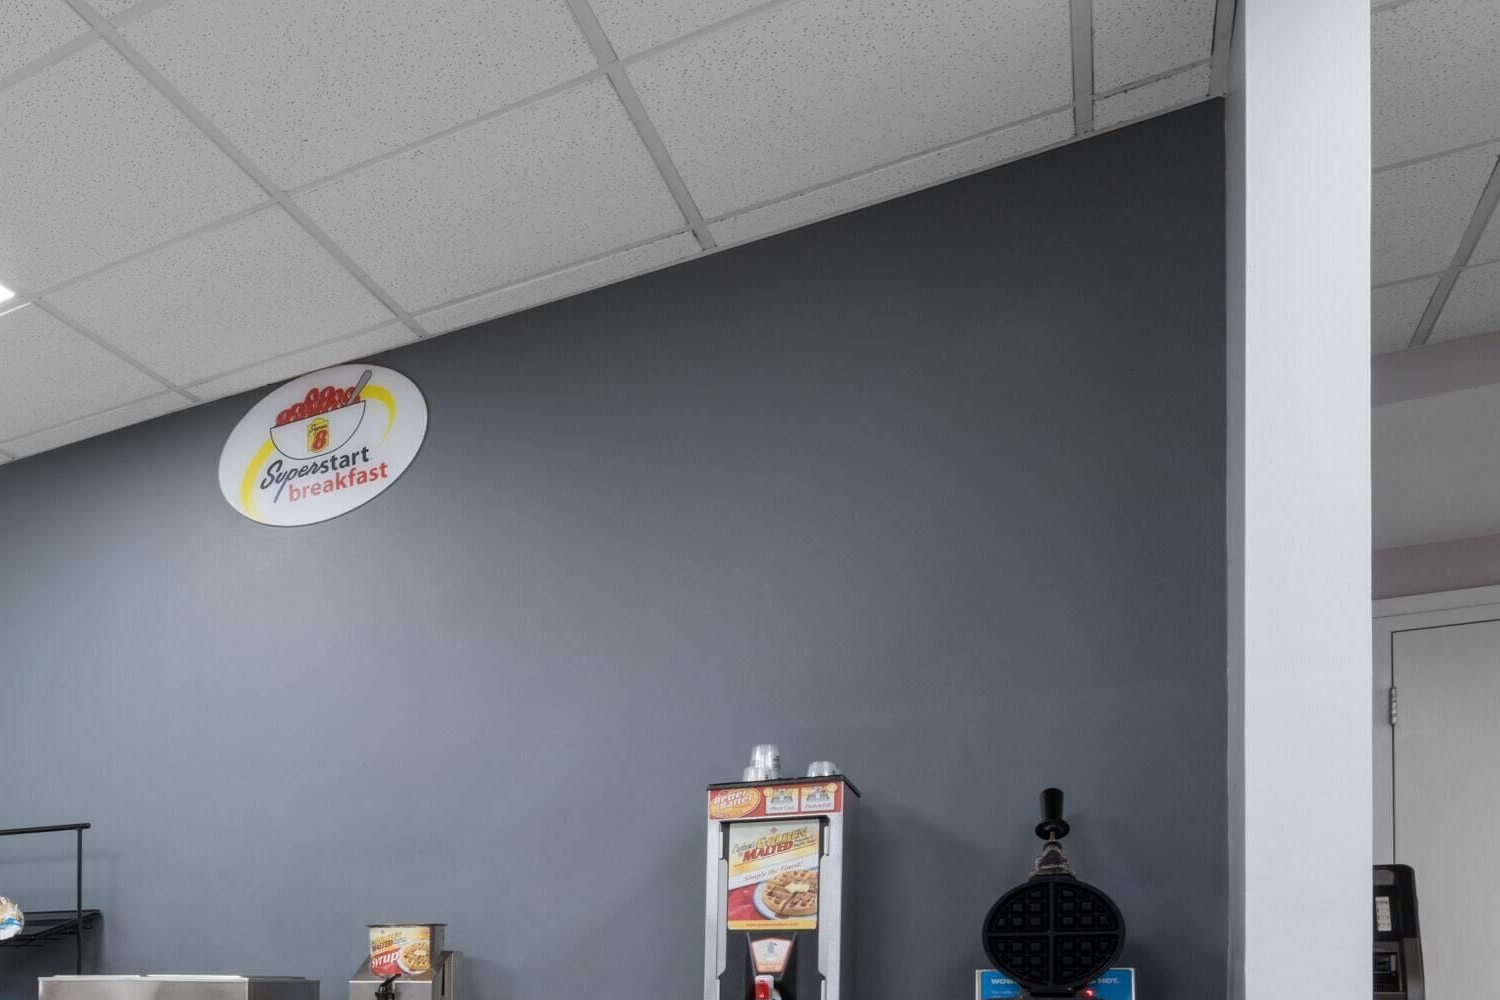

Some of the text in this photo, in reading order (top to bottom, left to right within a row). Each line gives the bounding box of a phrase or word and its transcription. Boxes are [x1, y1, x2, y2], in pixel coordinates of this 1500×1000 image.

[311, 429, 328, 452] 8
[260, 446, 369, 503] Superstart
[288, 462, 388, 502] breakfast
[713, 791, 749, 805] Better
[720, 795, 752, 809] Batter
[756, 827, 807, 849] GOLDEN
[742, 840, 793, 863] MALTED
[745, 871, 767, 881] Simply
[372, 951, 399, 969] Syrup
